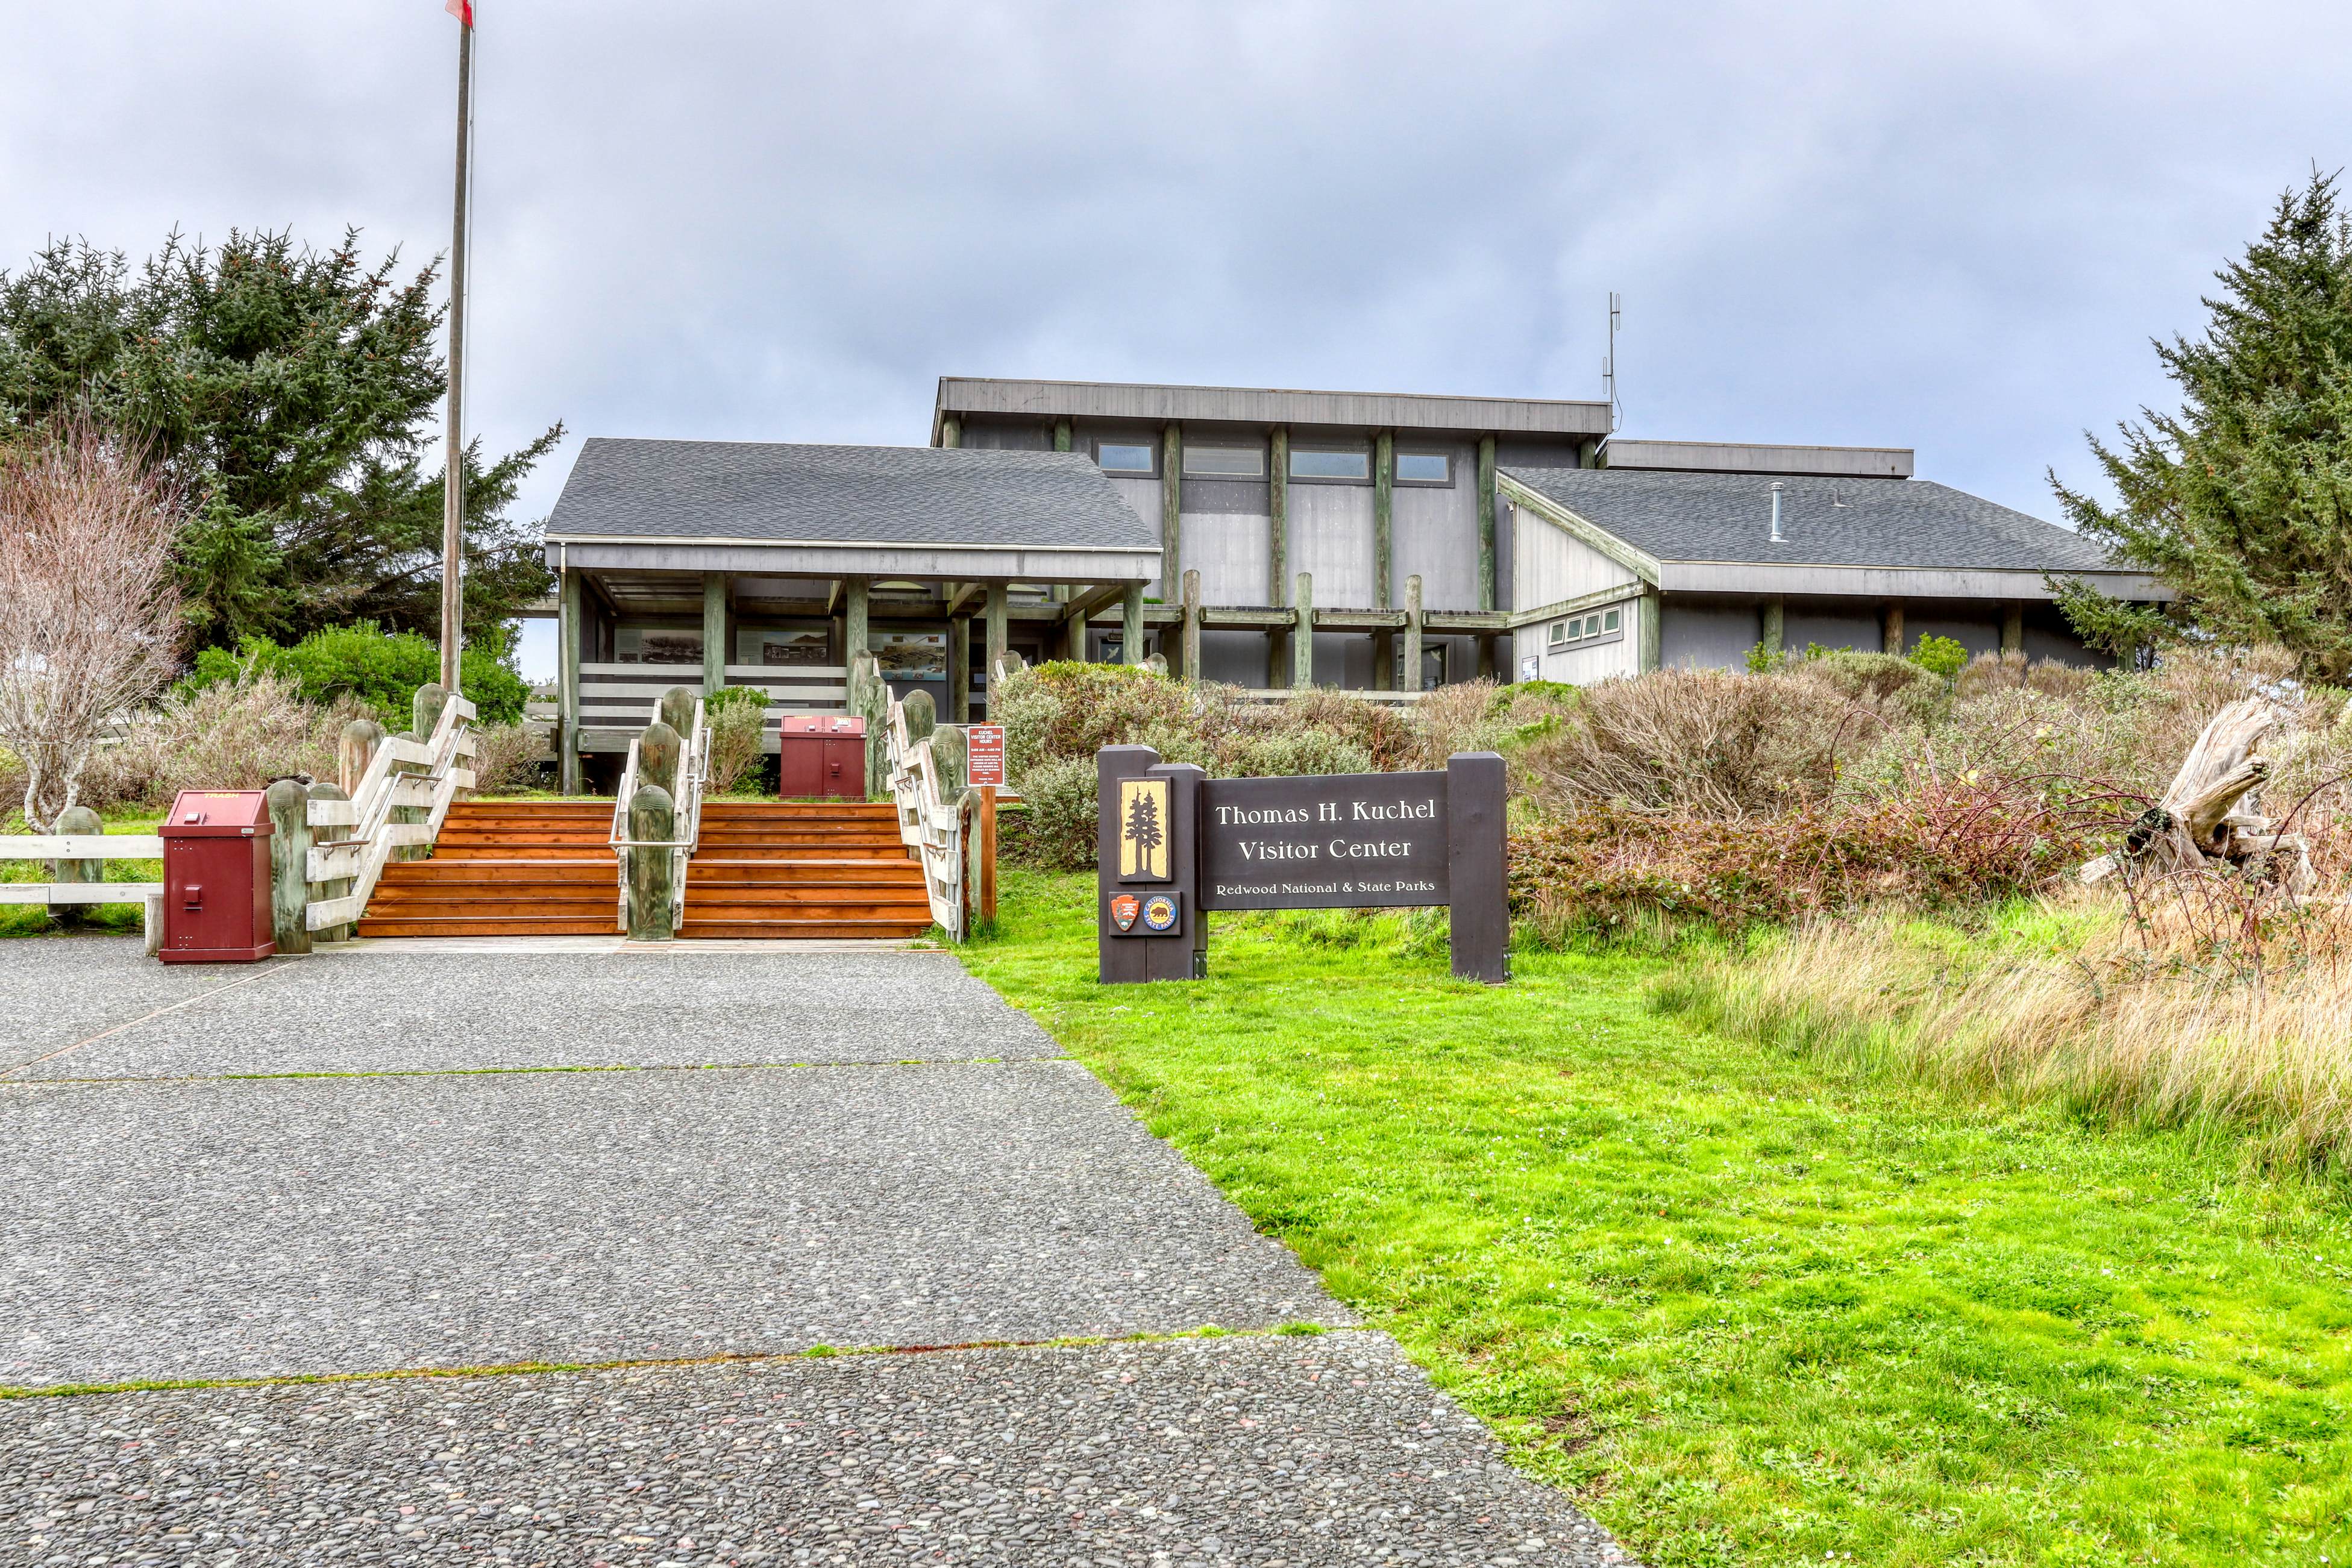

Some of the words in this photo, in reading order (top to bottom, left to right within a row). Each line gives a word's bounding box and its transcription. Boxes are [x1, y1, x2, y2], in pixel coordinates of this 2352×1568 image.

[1215, 806, 1308, 824] Thomas
[1319, 803, 1342, 823] H.
[1352, 799, 1435, 820] Kuchel
[1239, 841, 1319, 860] Visitor
[1329, 839, 1411, 858] Center
[1217, 884, 1277, 895] Redwood
[1282, 883, 1337, 893] National
[1343, 882, 1352, 892] &
[1358, 882, 1391, 892] State
[1396, 881, 1435, 891] Parks
[1146, 898, 1174, 912] CALIFORNIA
[1146, 915, 1159, 929] STATE
[1161, 915, 1174, 929] PARKS
